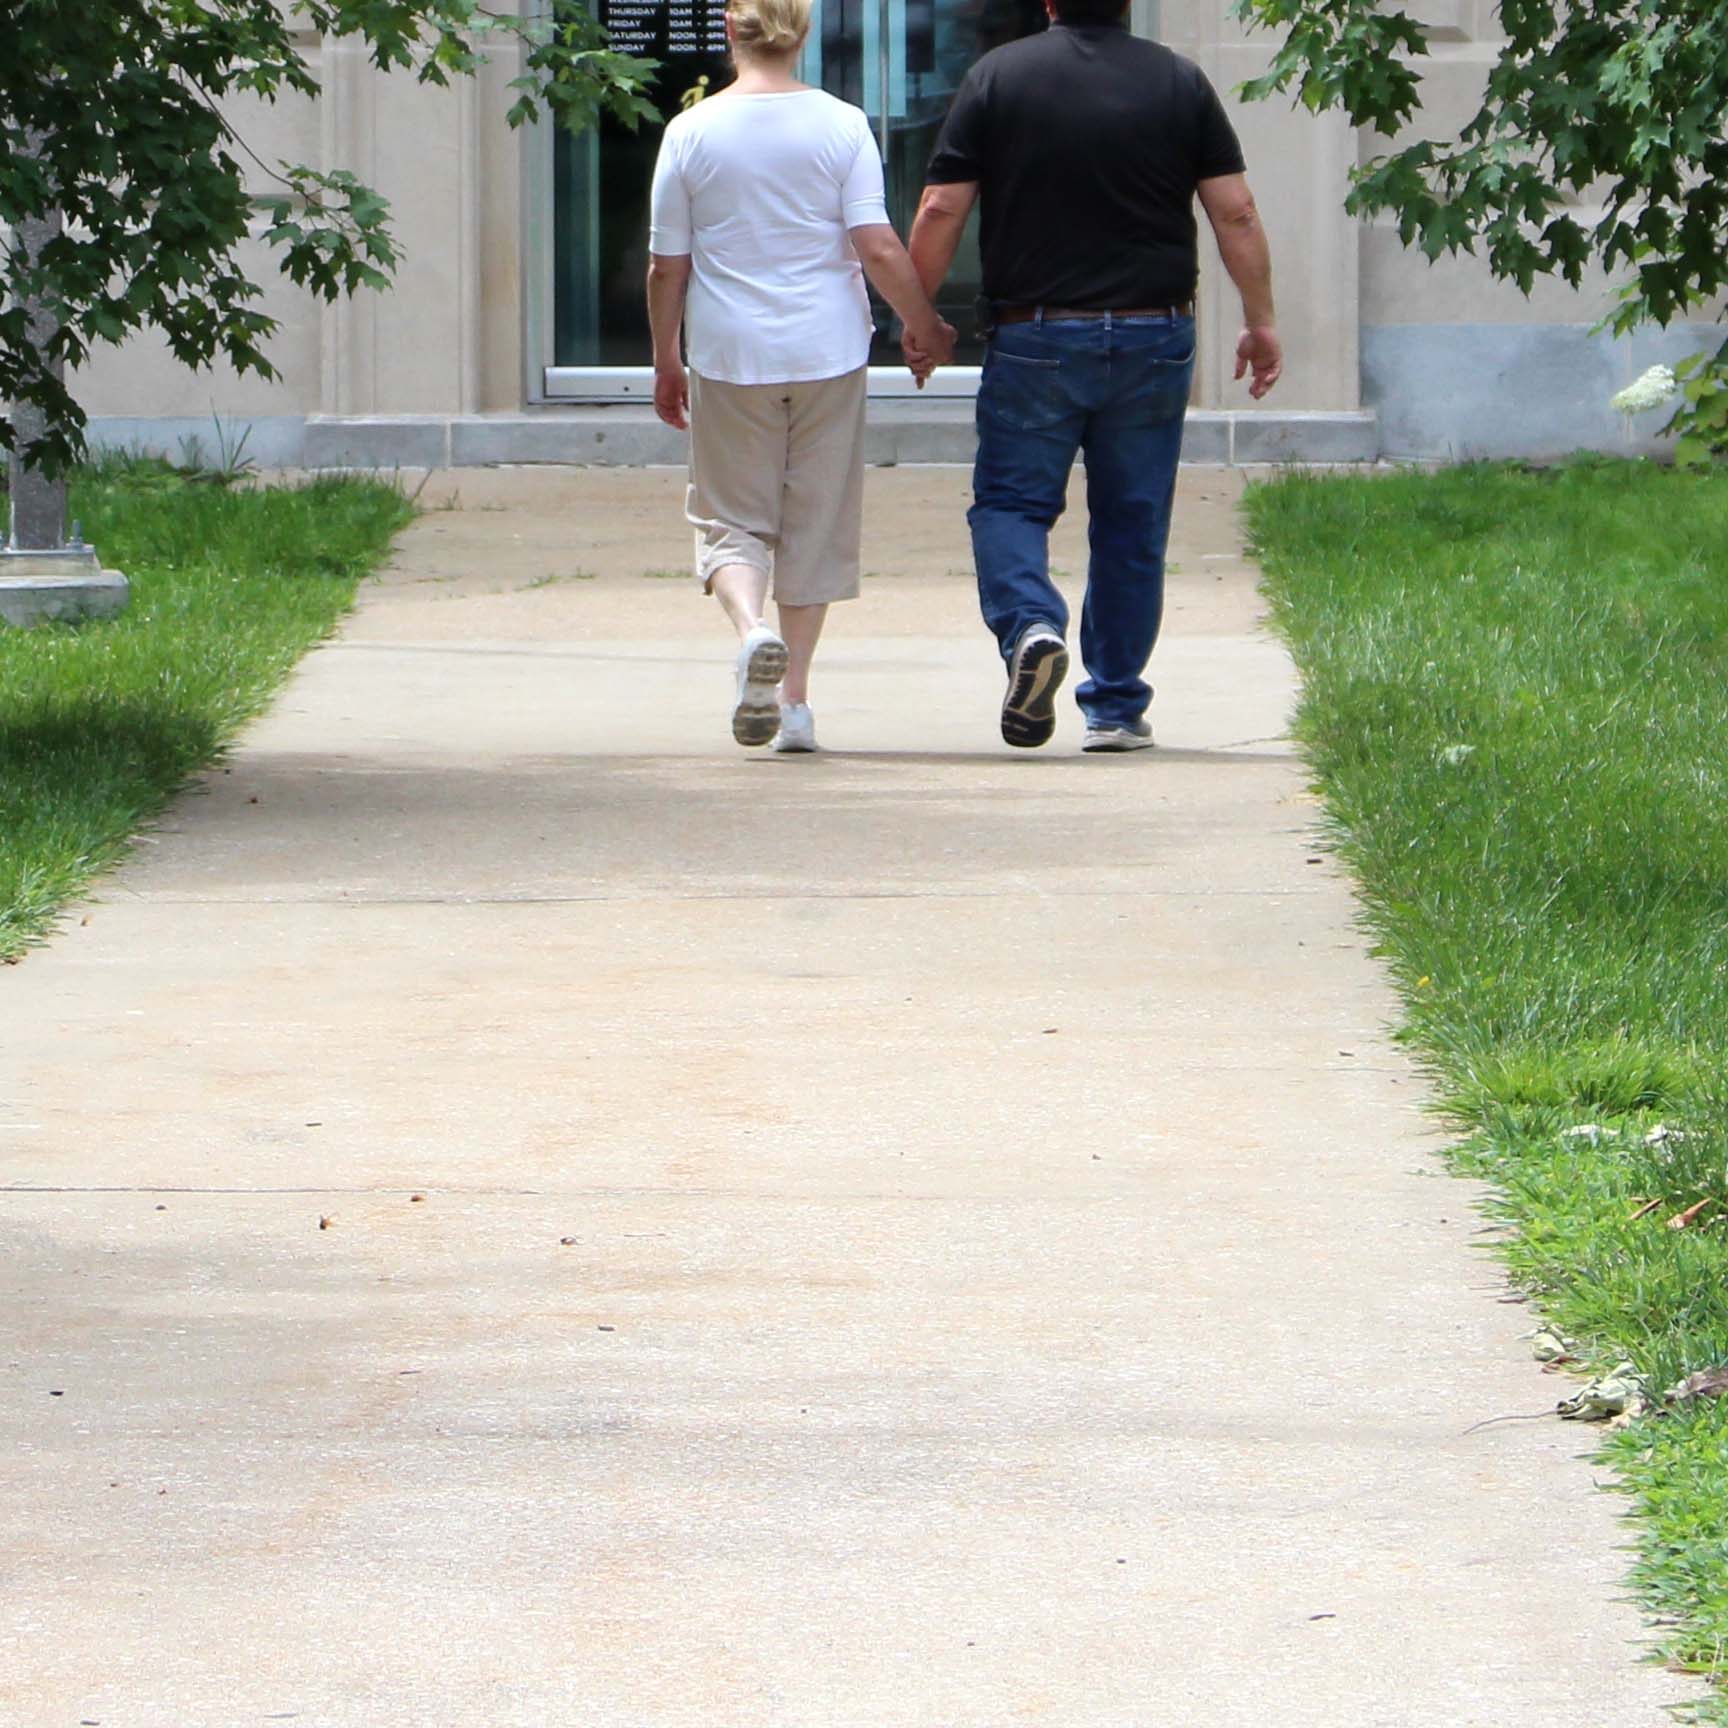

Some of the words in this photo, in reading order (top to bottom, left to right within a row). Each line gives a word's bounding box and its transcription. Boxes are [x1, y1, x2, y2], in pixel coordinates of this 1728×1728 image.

[608, 7, 656, 16] THURSDAY
[669, 7, 693, 16] 10AM
[607, 19, 641, 28] FRIDAY
[669, 19, 693, 28] 10AM
[668, 31, 697, 40] NOON
[608, 43, 645, 52] SUNDAY
[668, 43, 697, 52] NOON
